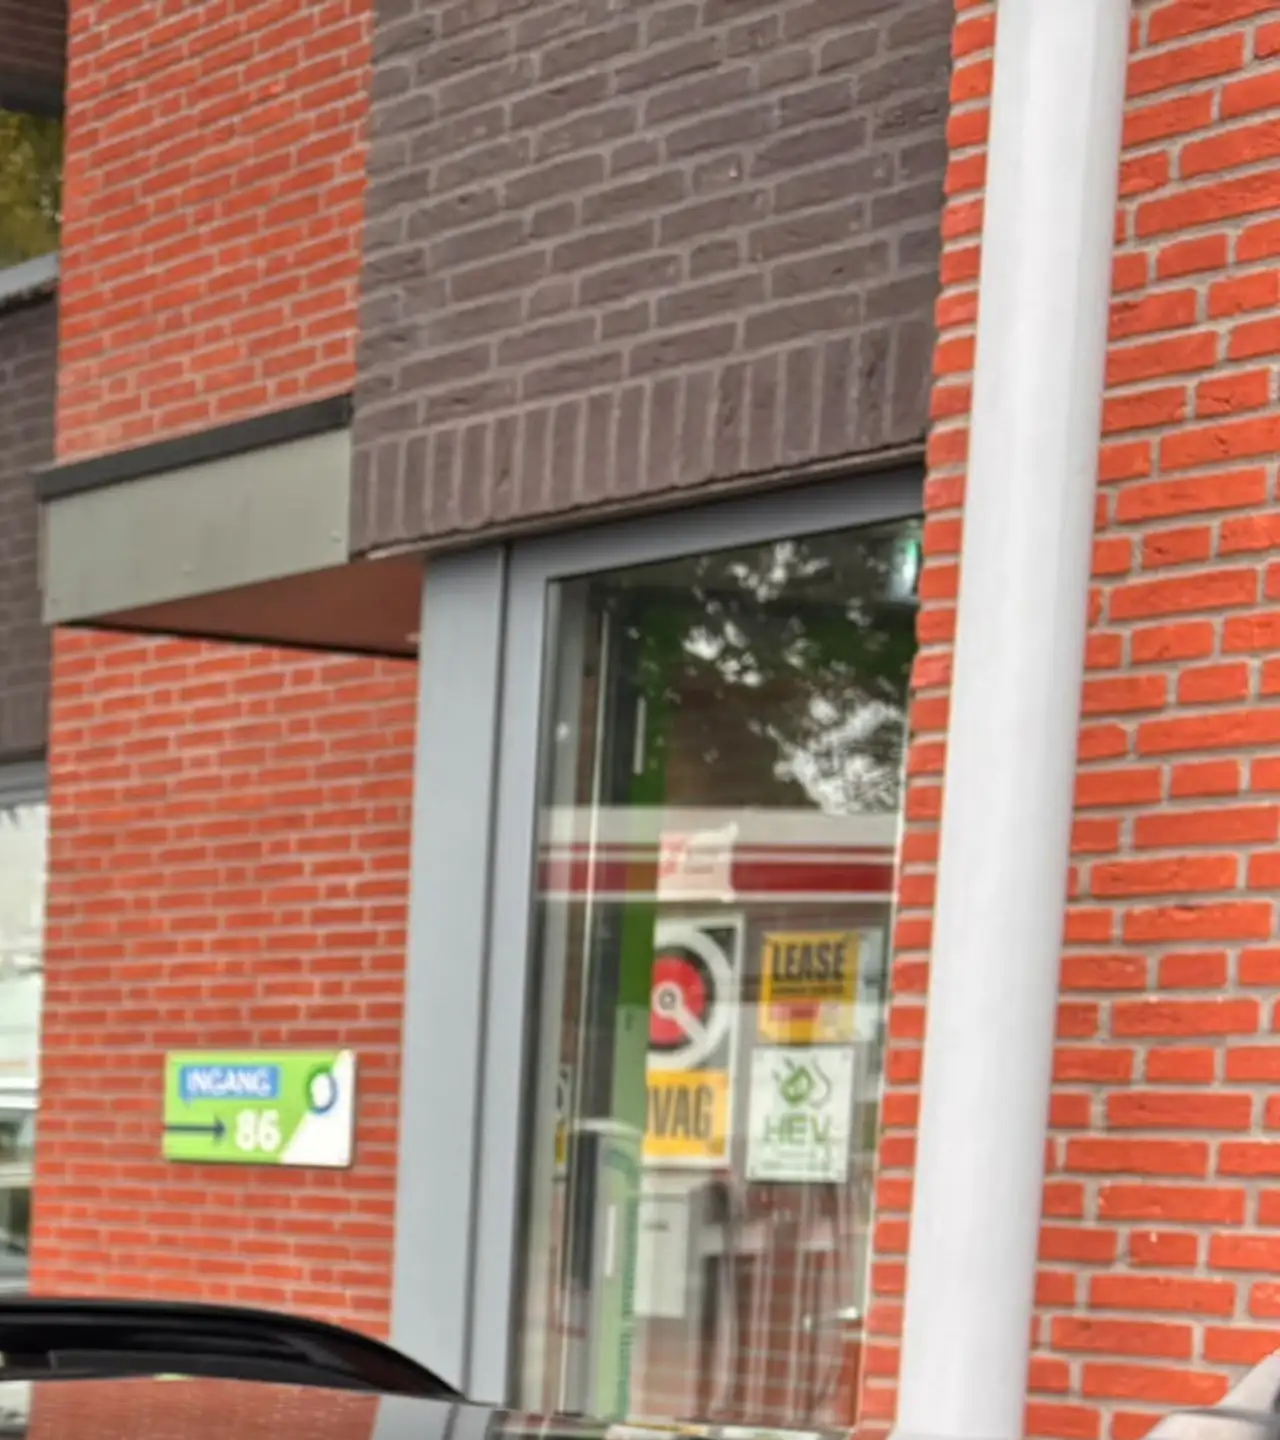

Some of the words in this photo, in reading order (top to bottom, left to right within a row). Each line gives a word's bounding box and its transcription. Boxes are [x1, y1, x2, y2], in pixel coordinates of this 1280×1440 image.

[771, 942, 846, 980] LEASE
[186, 1066, 272, 1098] INGANG
[236, 1109, 281, 1151] 86
[646, 1085, 714, 1140] VAG
